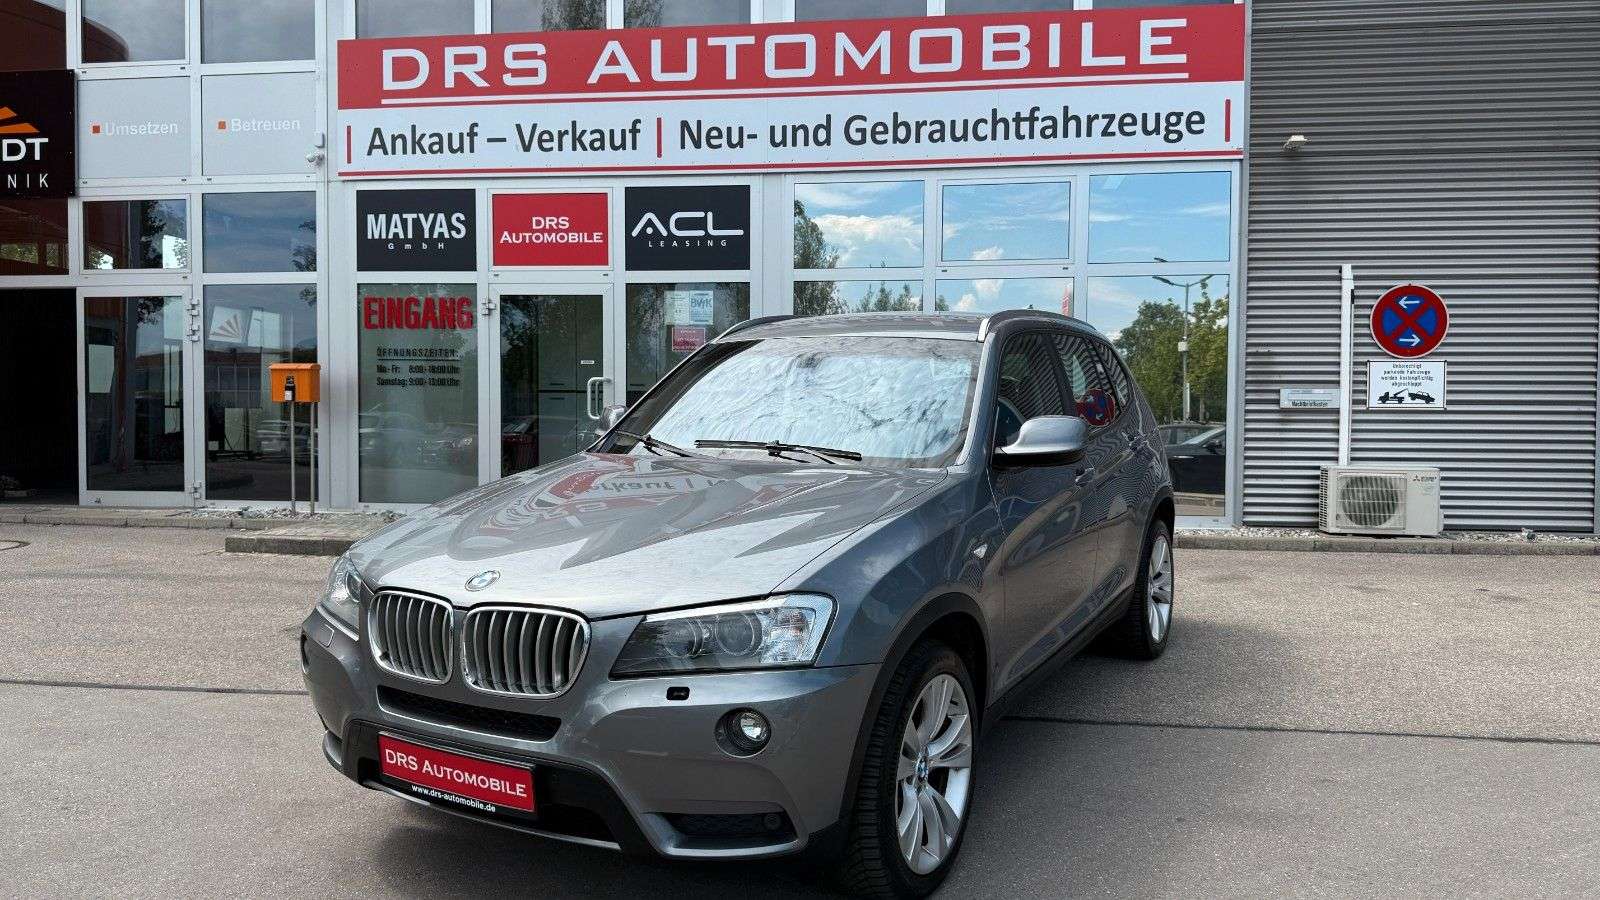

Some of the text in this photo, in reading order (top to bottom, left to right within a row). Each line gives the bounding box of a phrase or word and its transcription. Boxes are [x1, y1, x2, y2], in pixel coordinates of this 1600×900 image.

[382, 18, 1188, 91] DRS AUTOMOBILE
[105, 121, 178, 136] Umsetzen
[230, 117, 301, 132] Betreuen
[367, 122, 479, 156] Ankauf
[515, 118, 642, 153] Verkauf
[680, 118, 758, 150] Neu-
[770, 113, 832, 148] und
[843, 105, 1206, 147] Gebrauchtfahrzeuge
[366, 212, 467, 240] MATYAS
[531, 216, 570, 230] DRS
[631, 211, 745, 237] ACL
[387, 242, 445, 250] GmbH
[499, 230, 604, 244] AUTOMOBILE
[648, 239, 728, 248] LEASING
[363, 296, 474, 330] EINGANG
[384, 748, 528, 798] DRS AUTOMOBILE
[411, 784, 496, 813] www.drs-automobile.de
